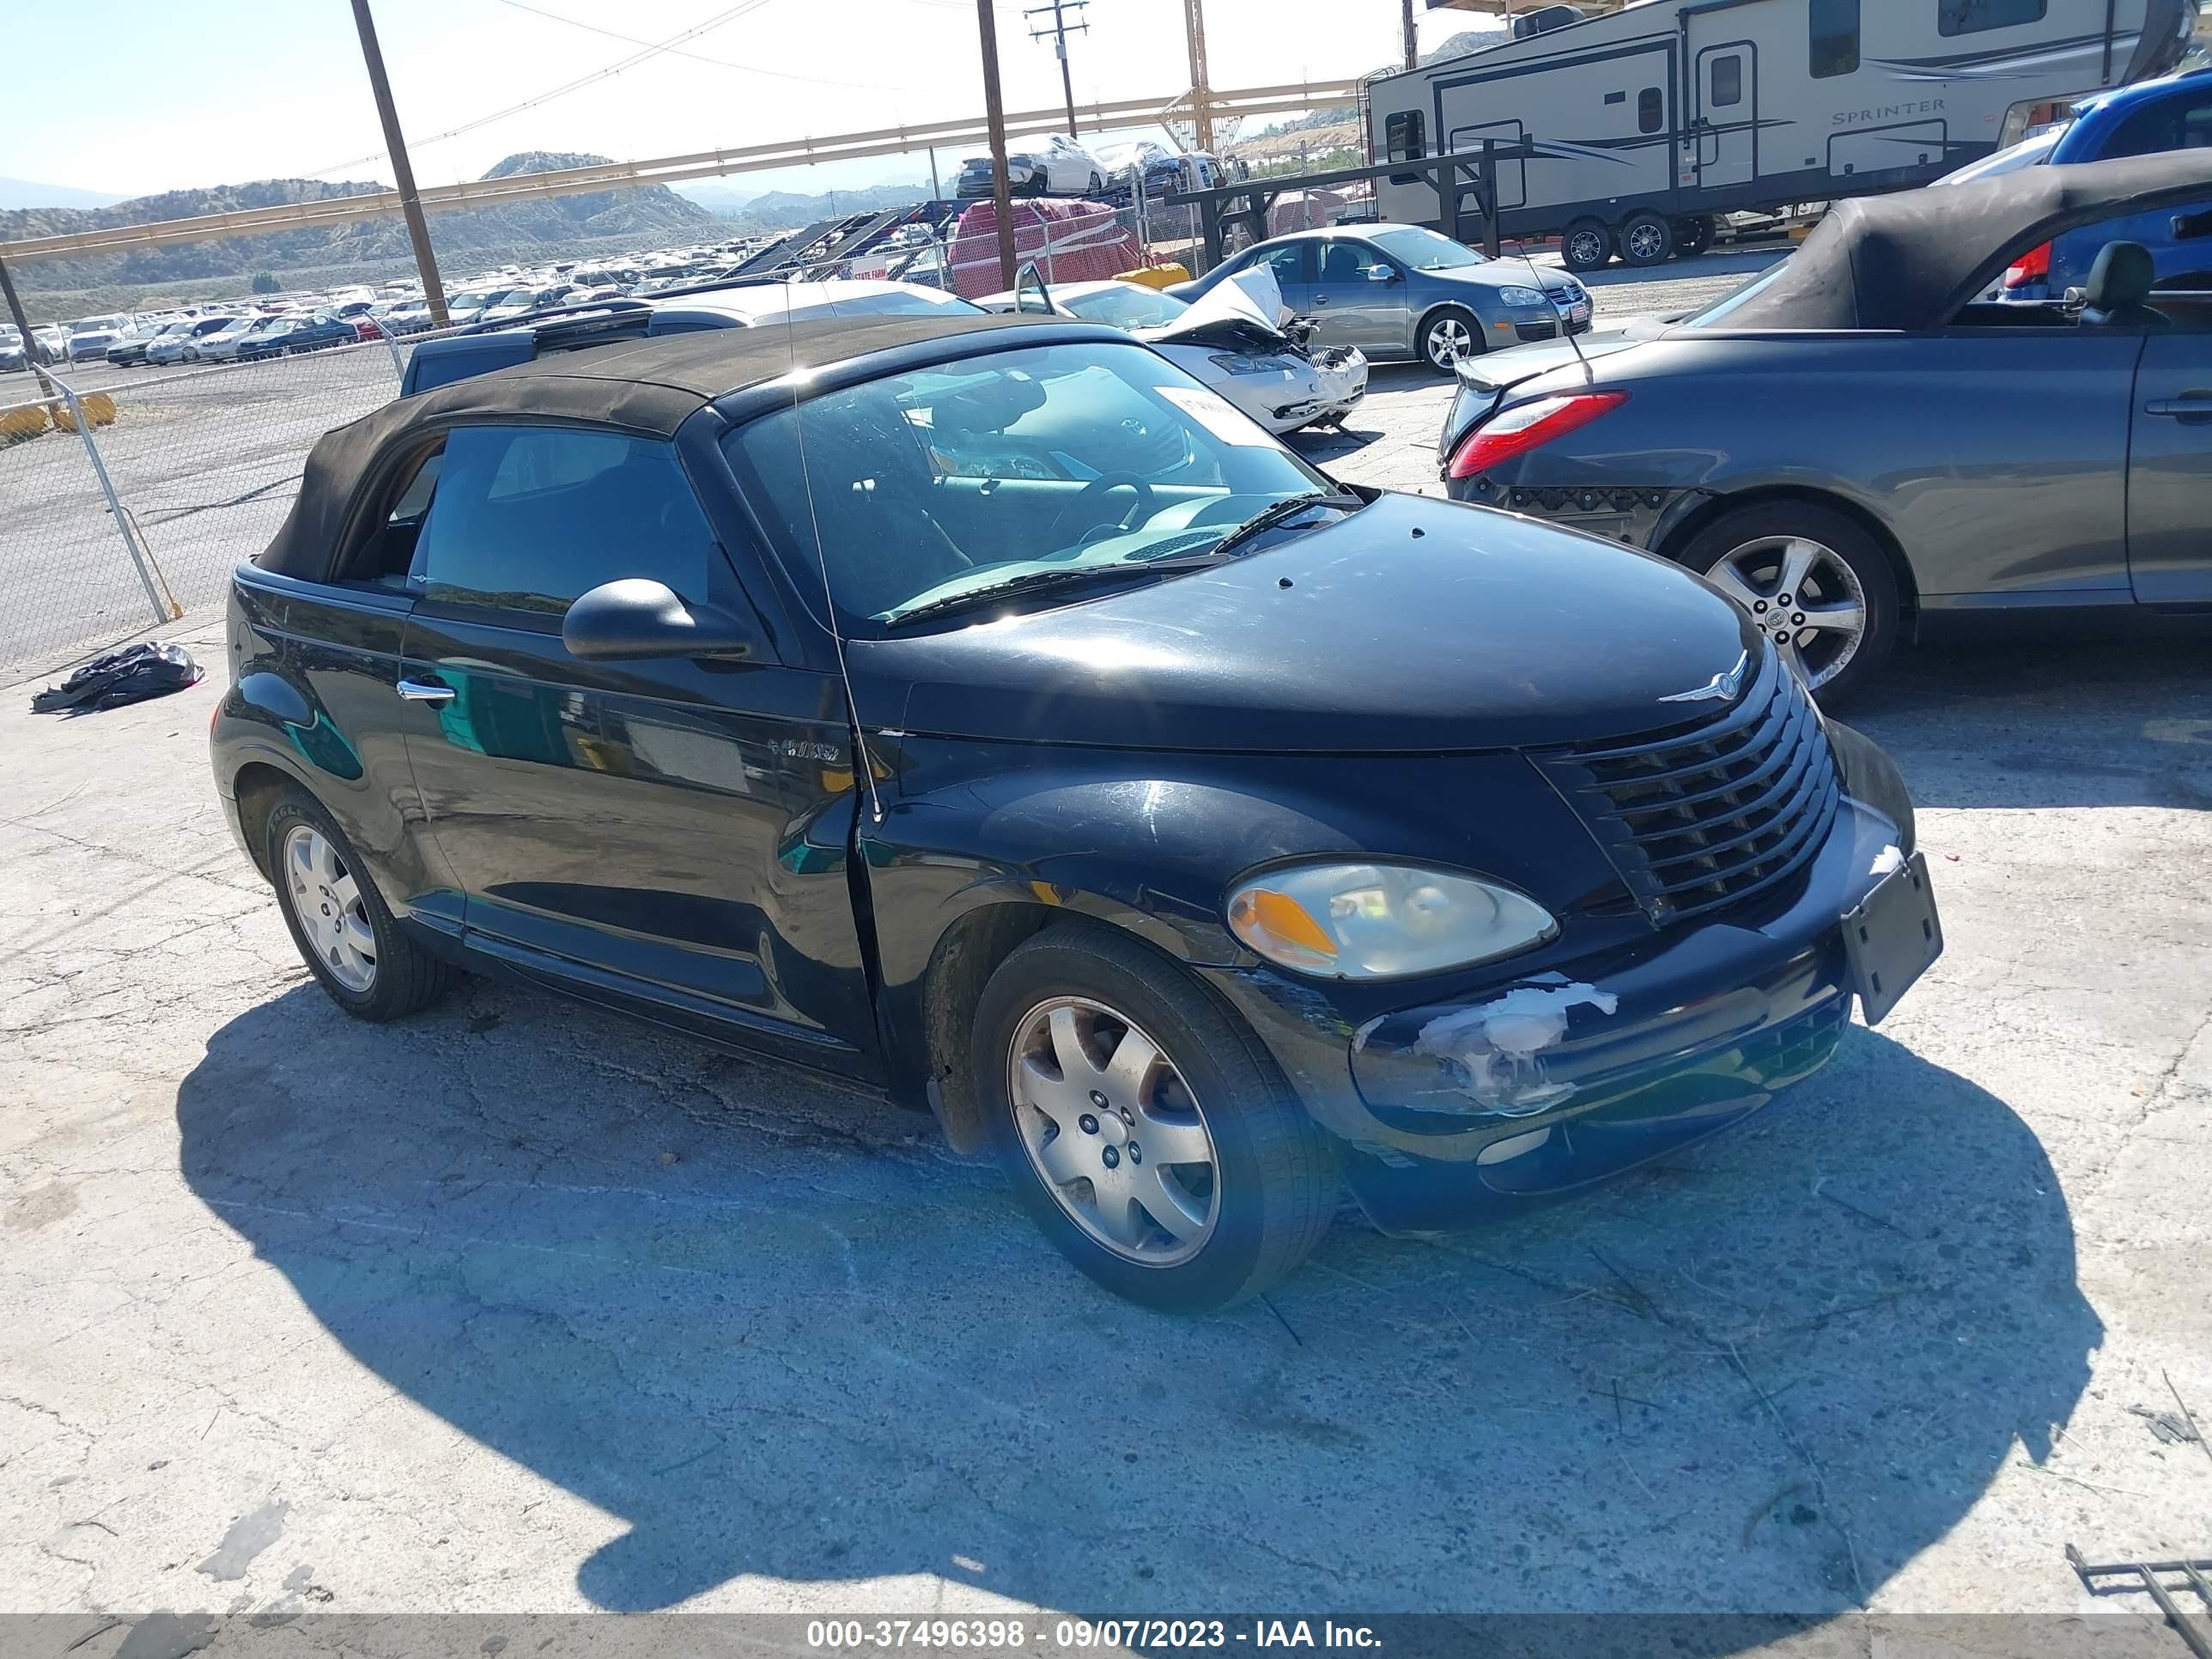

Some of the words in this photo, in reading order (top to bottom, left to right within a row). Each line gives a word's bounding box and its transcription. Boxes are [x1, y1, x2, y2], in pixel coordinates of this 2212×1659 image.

[1832, 99, 1946, 125] SPRINTER
[854, 271, 872, 280] STATE
[872, 269, 886, 279] FARM
